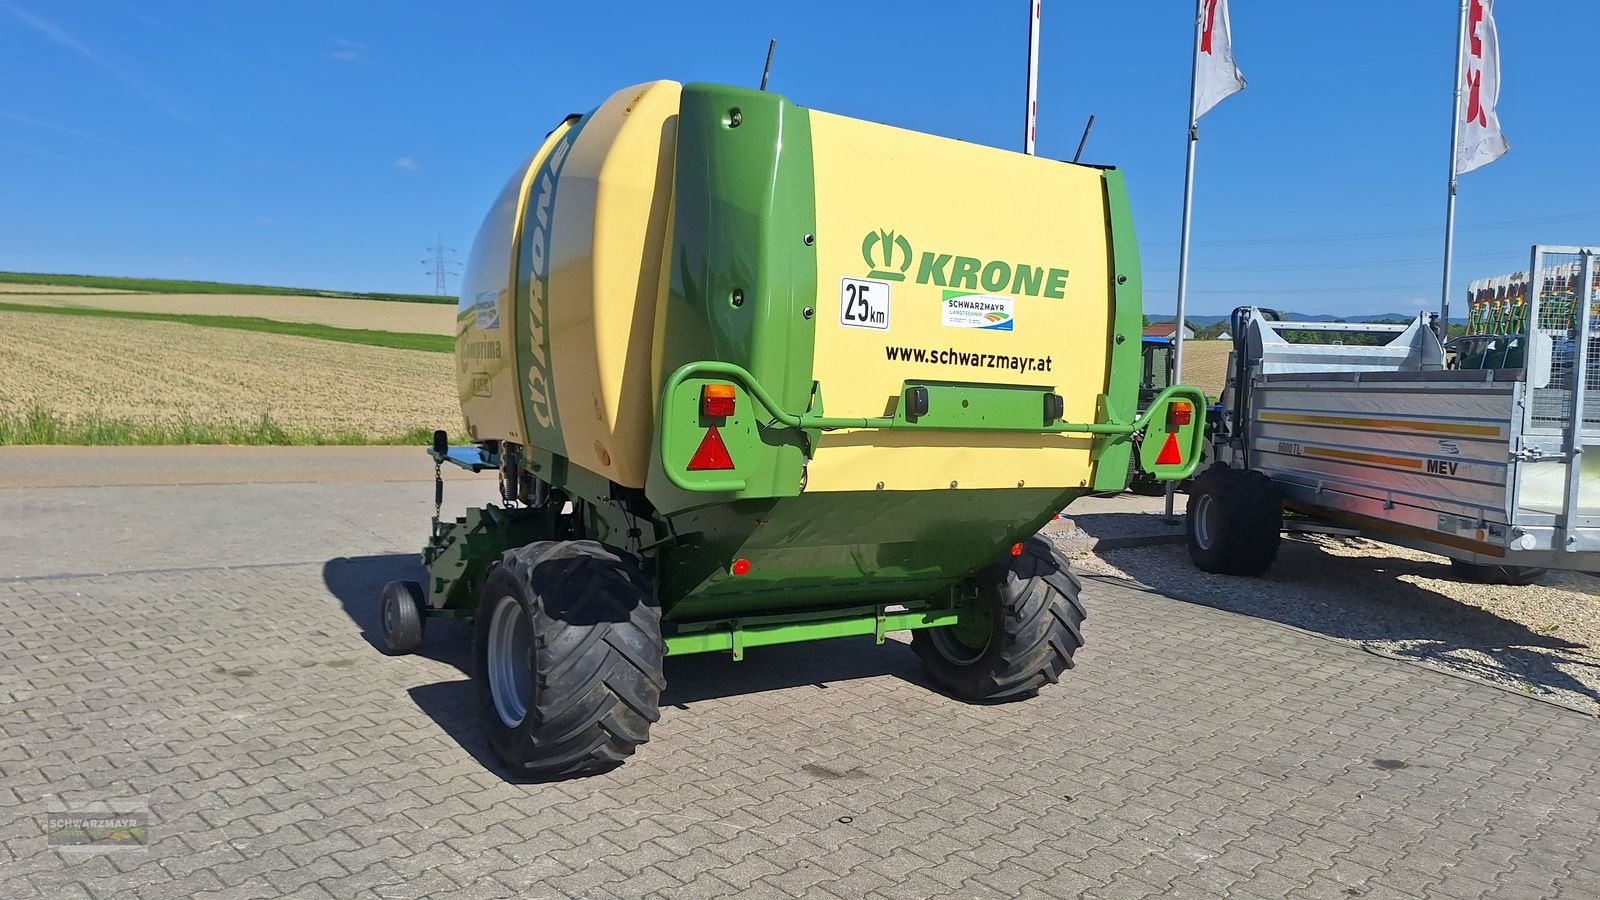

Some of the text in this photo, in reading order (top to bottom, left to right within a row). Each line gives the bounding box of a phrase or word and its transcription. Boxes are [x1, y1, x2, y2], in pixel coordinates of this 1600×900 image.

[529, 137, 569, 368] KRONE
[916, 252, 1069, 299] KRONE
[845, 283, 885, 325] 25 km
[948, 299, 1005, 312] SCHWARZMAYR
[885, 345, 1052, 374] www.schwarzmayr.at
[1426, 459, 1459, 476] MEV
